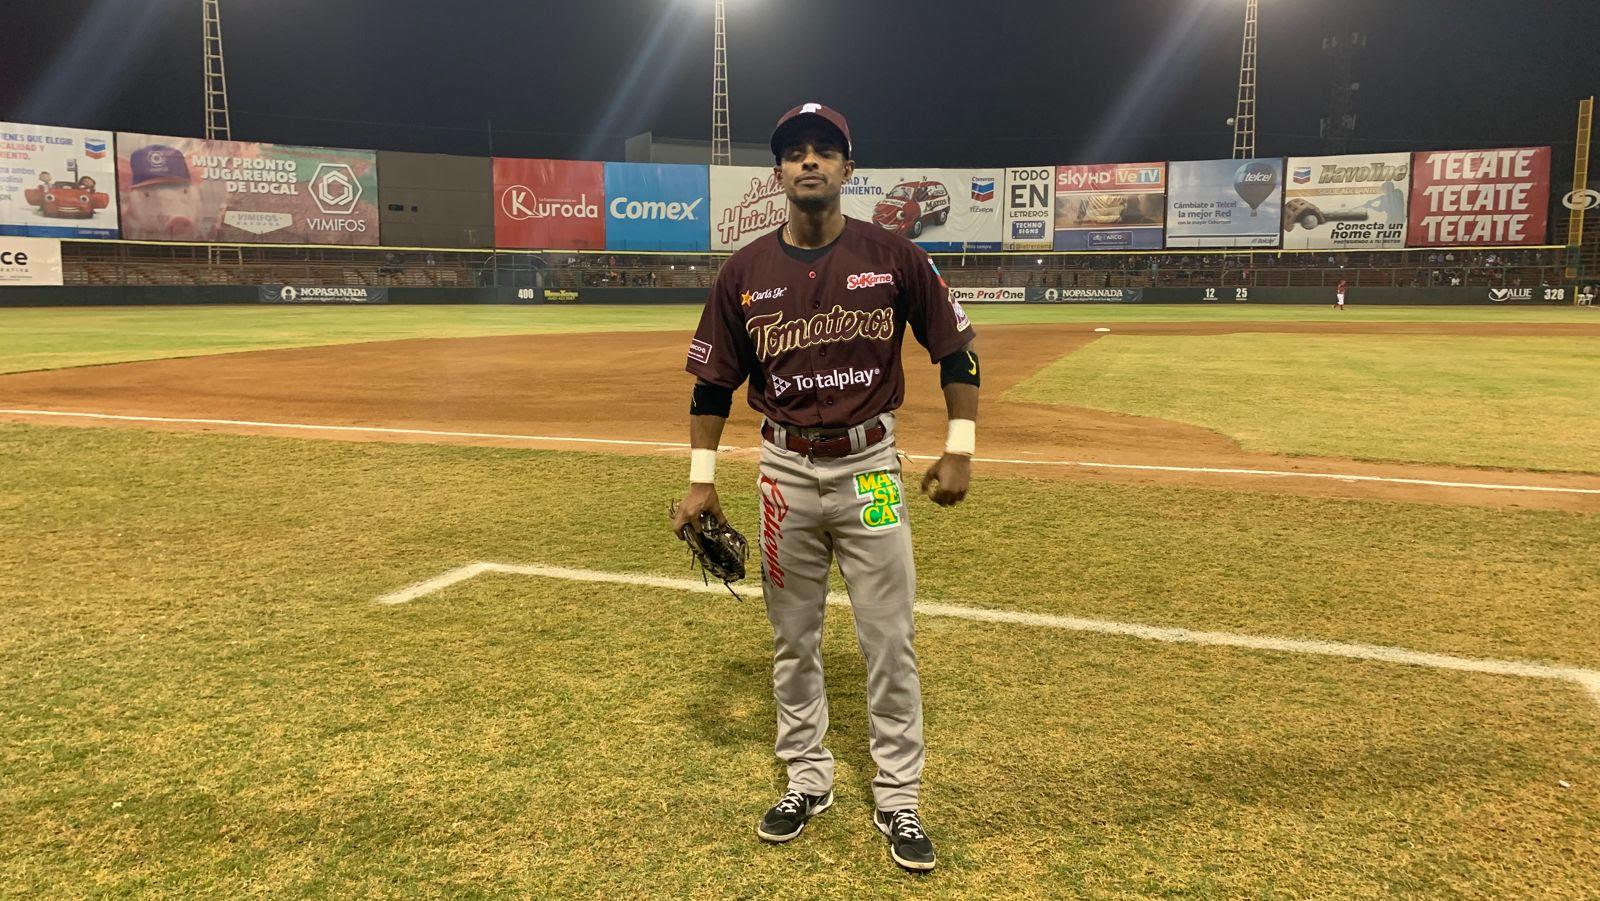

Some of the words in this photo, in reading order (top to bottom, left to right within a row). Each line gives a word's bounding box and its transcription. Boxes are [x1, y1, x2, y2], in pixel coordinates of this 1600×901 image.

[27, 135, 43, 143] QUE
[40, 144, 45, 152] Y
[192, 155, 229, 168] MUY
[232, 157, 296, 171] PRONTO
[1425, 150, 1537, 180] TECATE
[201, 168, 297, 183] JUGAREMOS
[1011, 170, 1049, 181] TODO
[1318, 162, 1409, 184] Havoline
[863, 177, 868, 185] Y
[226, 182, 247, 192] DE
[250, 182, 298, 195] LOCAL
[1011, 184, 1048, 208] EN
[1423, 182, 1534, 212] TECATE
[610, 197, 703, 221] Comex
[1178, 210, 1186, 218] la
[1187, 211, 1213, 220] mejor
[306, 218, 365, 232] VIMIFOS
[1336, 222, 1385, 231] Conecta
[1420, 214, 1531, 242] TECATE
[1331, 229, 1371, 239] home
[1376, 230, 1402, 238] run
[300, 288, 368, 297] NOPASANADA
[517, 289, 534, 299] 400
[953, 290, 974, 299] One
[1062, 289, 1123, 298] NOPASANADA
[1205, 288, 1215, 298] 12
[1236, 288, 1248, 298] 25
[1544, 288, 1565, 300] 328
[747, 304, 894, 362] Tomateros
[858, 471, 892, 493] MA
[864, 505, 897, 527] CA
